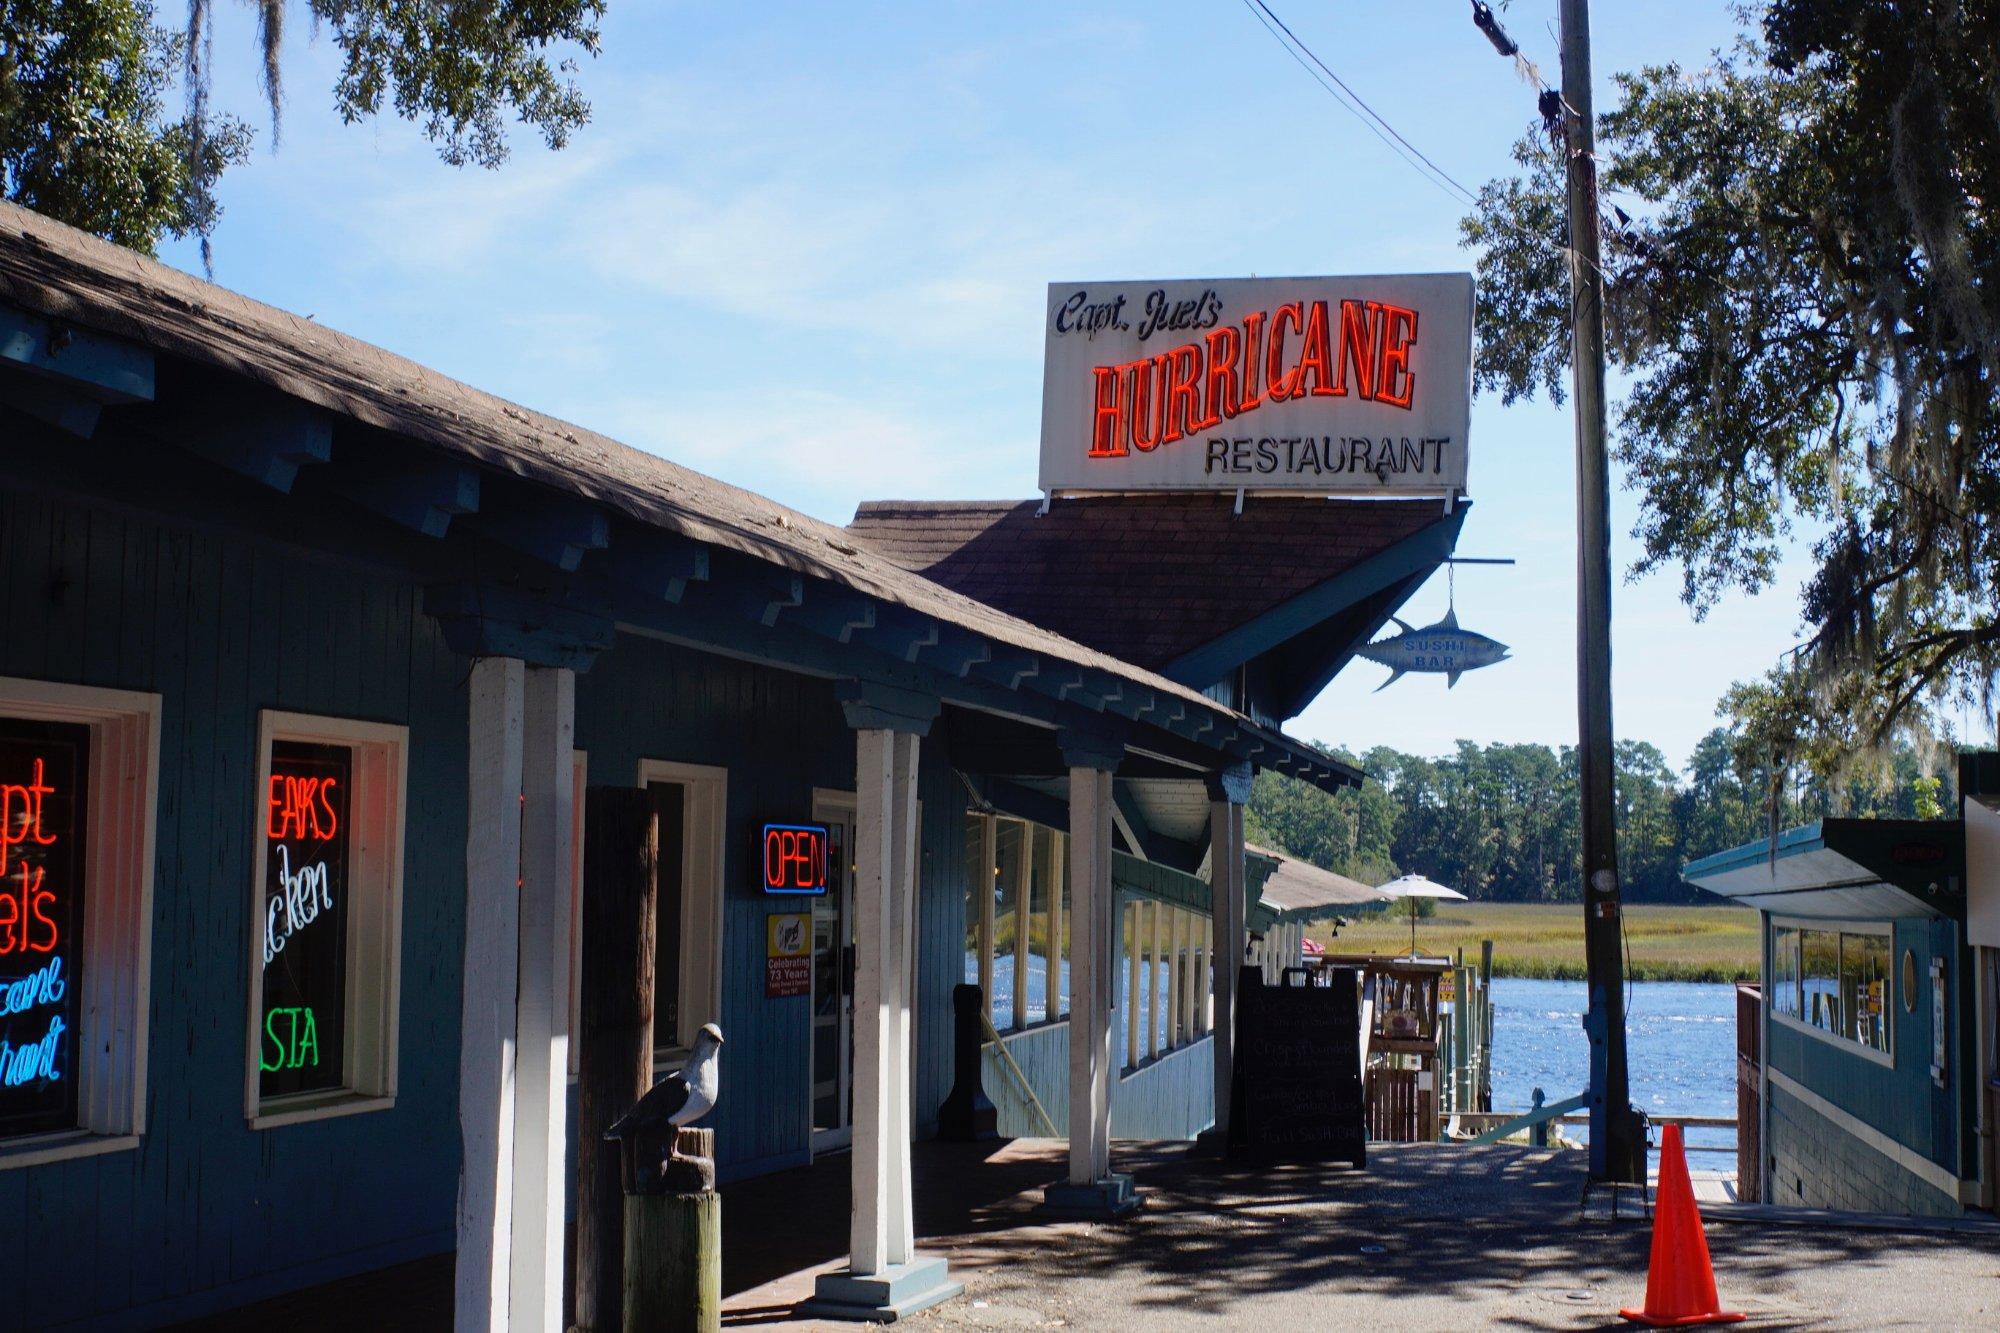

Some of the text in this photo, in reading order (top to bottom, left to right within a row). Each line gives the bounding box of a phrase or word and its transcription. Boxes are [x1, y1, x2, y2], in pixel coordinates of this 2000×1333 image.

[1056, 290, 1130, 341] Capt.
[1088, 299, 1419, 458] HURRICANE
[1206, 436, 1450, 476] RESTAURANT
[1404, 639, 1464, 651] SUSHI
[1415, 655, 1454, 667] BAR
[766, 830, 825, 887] OPEN
[768, 957, 810, 970] Celebrating
[784, 968, 809, 980] Years
